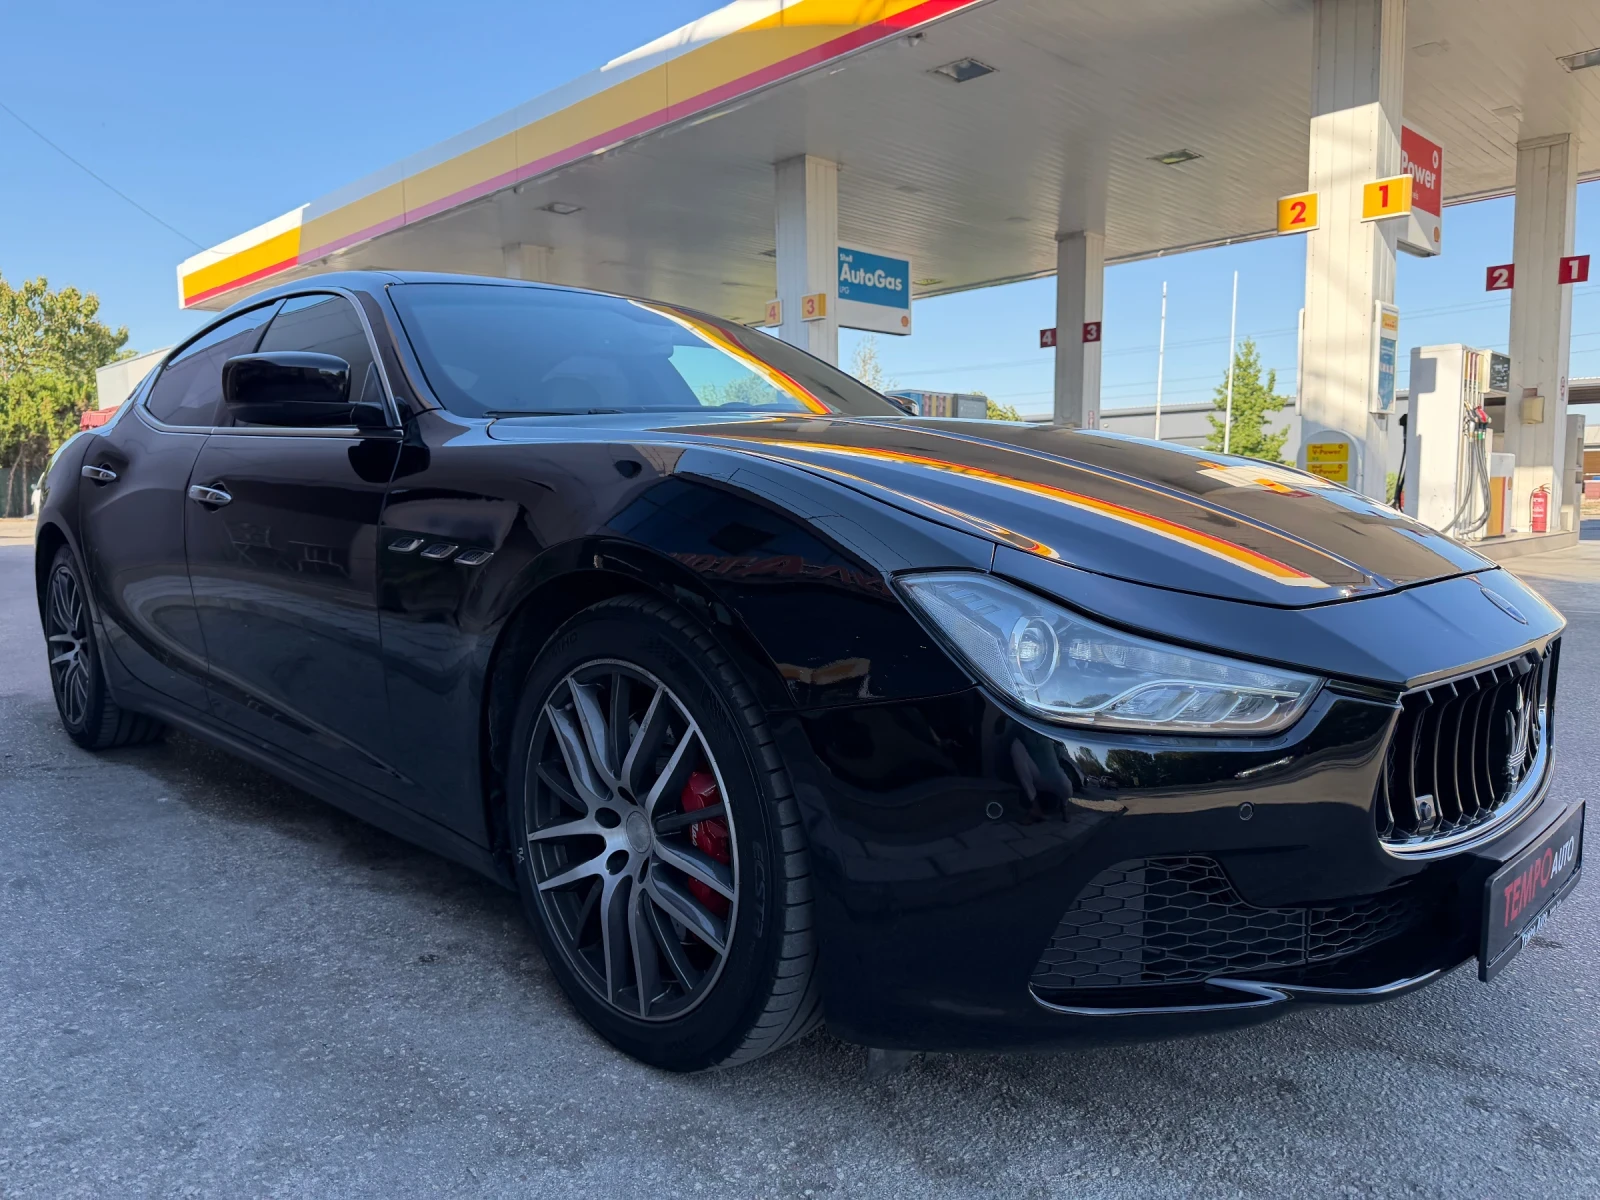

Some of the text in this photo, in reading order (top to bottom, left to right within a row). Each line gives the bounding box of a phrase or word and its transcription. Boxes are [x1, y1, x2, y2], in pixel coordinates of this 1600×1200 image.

[1401, 150, 1436, 190] Power
[1379, 185, 1389, 208] 1
[1290, 201, 1307, 224] 2
[840, 253, 853, 263] Shell
[839, 263, 903, 291] AutoGas
[1492, 269, 1509, 288] 2
[1569, 260, 1580, 280] 1
[839, 286, 850, 294] LPG
[769, 306, 777, 320] 4
[806, 299, 815, 315] 3
[1042, 330, 1053, 345] 4
[1086, 325, 1097, 340] 3
[1504, 835, 1575, 927] TEMPO AUTO
